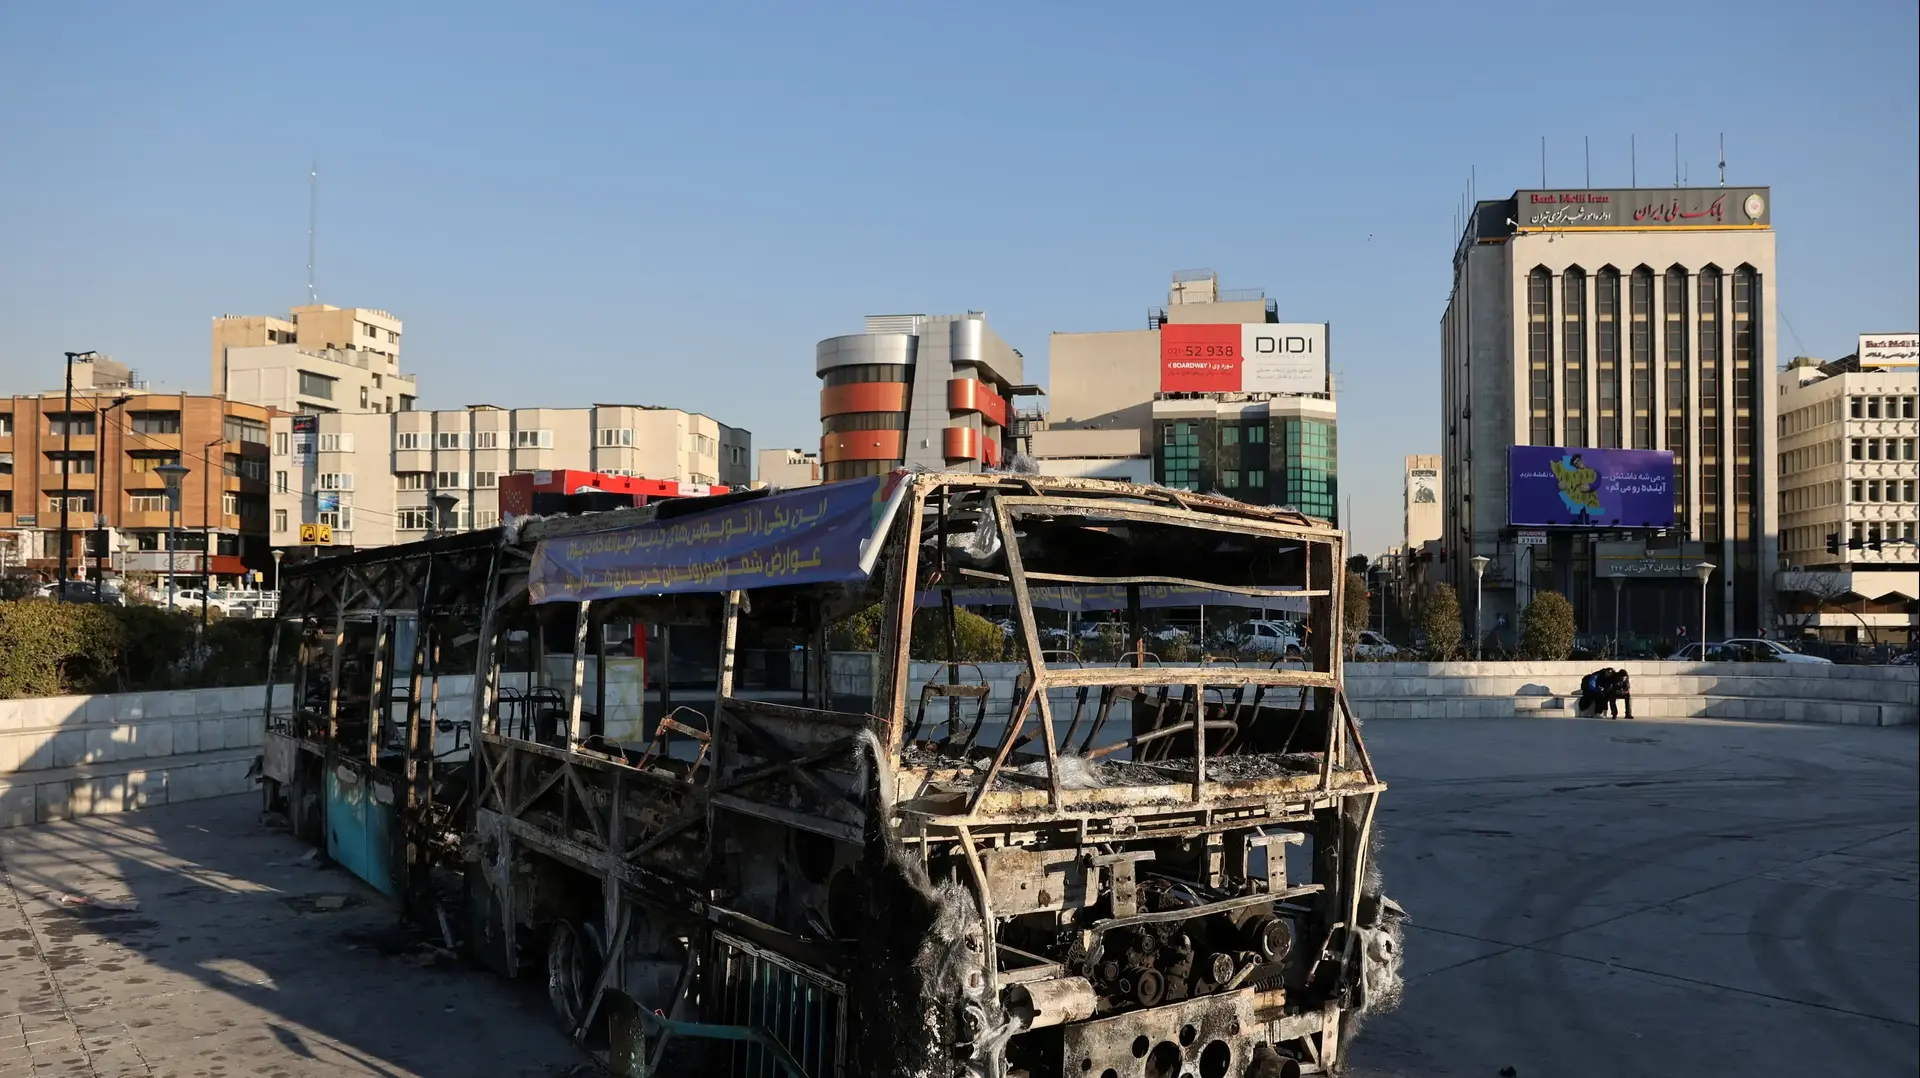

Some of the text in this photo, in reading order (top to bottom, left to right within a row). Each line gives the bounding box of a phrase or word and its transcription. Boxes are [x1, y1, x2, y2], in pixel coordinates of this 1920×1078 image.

[1531, 194, 1609, 204] Bank Melli Iran
[1633, 193, 1726, 222] بانک ملی ایران
[1531, 211, 1550, 223] تهران
[1595, 212, 1611, 220] اداره
[1186, 346, 1202, 356] 52
[1206, 346, 1233, 356] 938
[1256, 337, 1312, 353] DIDI
[1865, 340, 1887, 348] Bank
[1641, 482, 1666, 494] آینده
[753, 507, 763, 537] از
[764, 505, 790, 536] یکی
[791, 497, 828, 530] این
[638, 528, 666, 553] جدید
[724, 549, 764, 576] شما
[765, 546, 822, 578] عوارض
